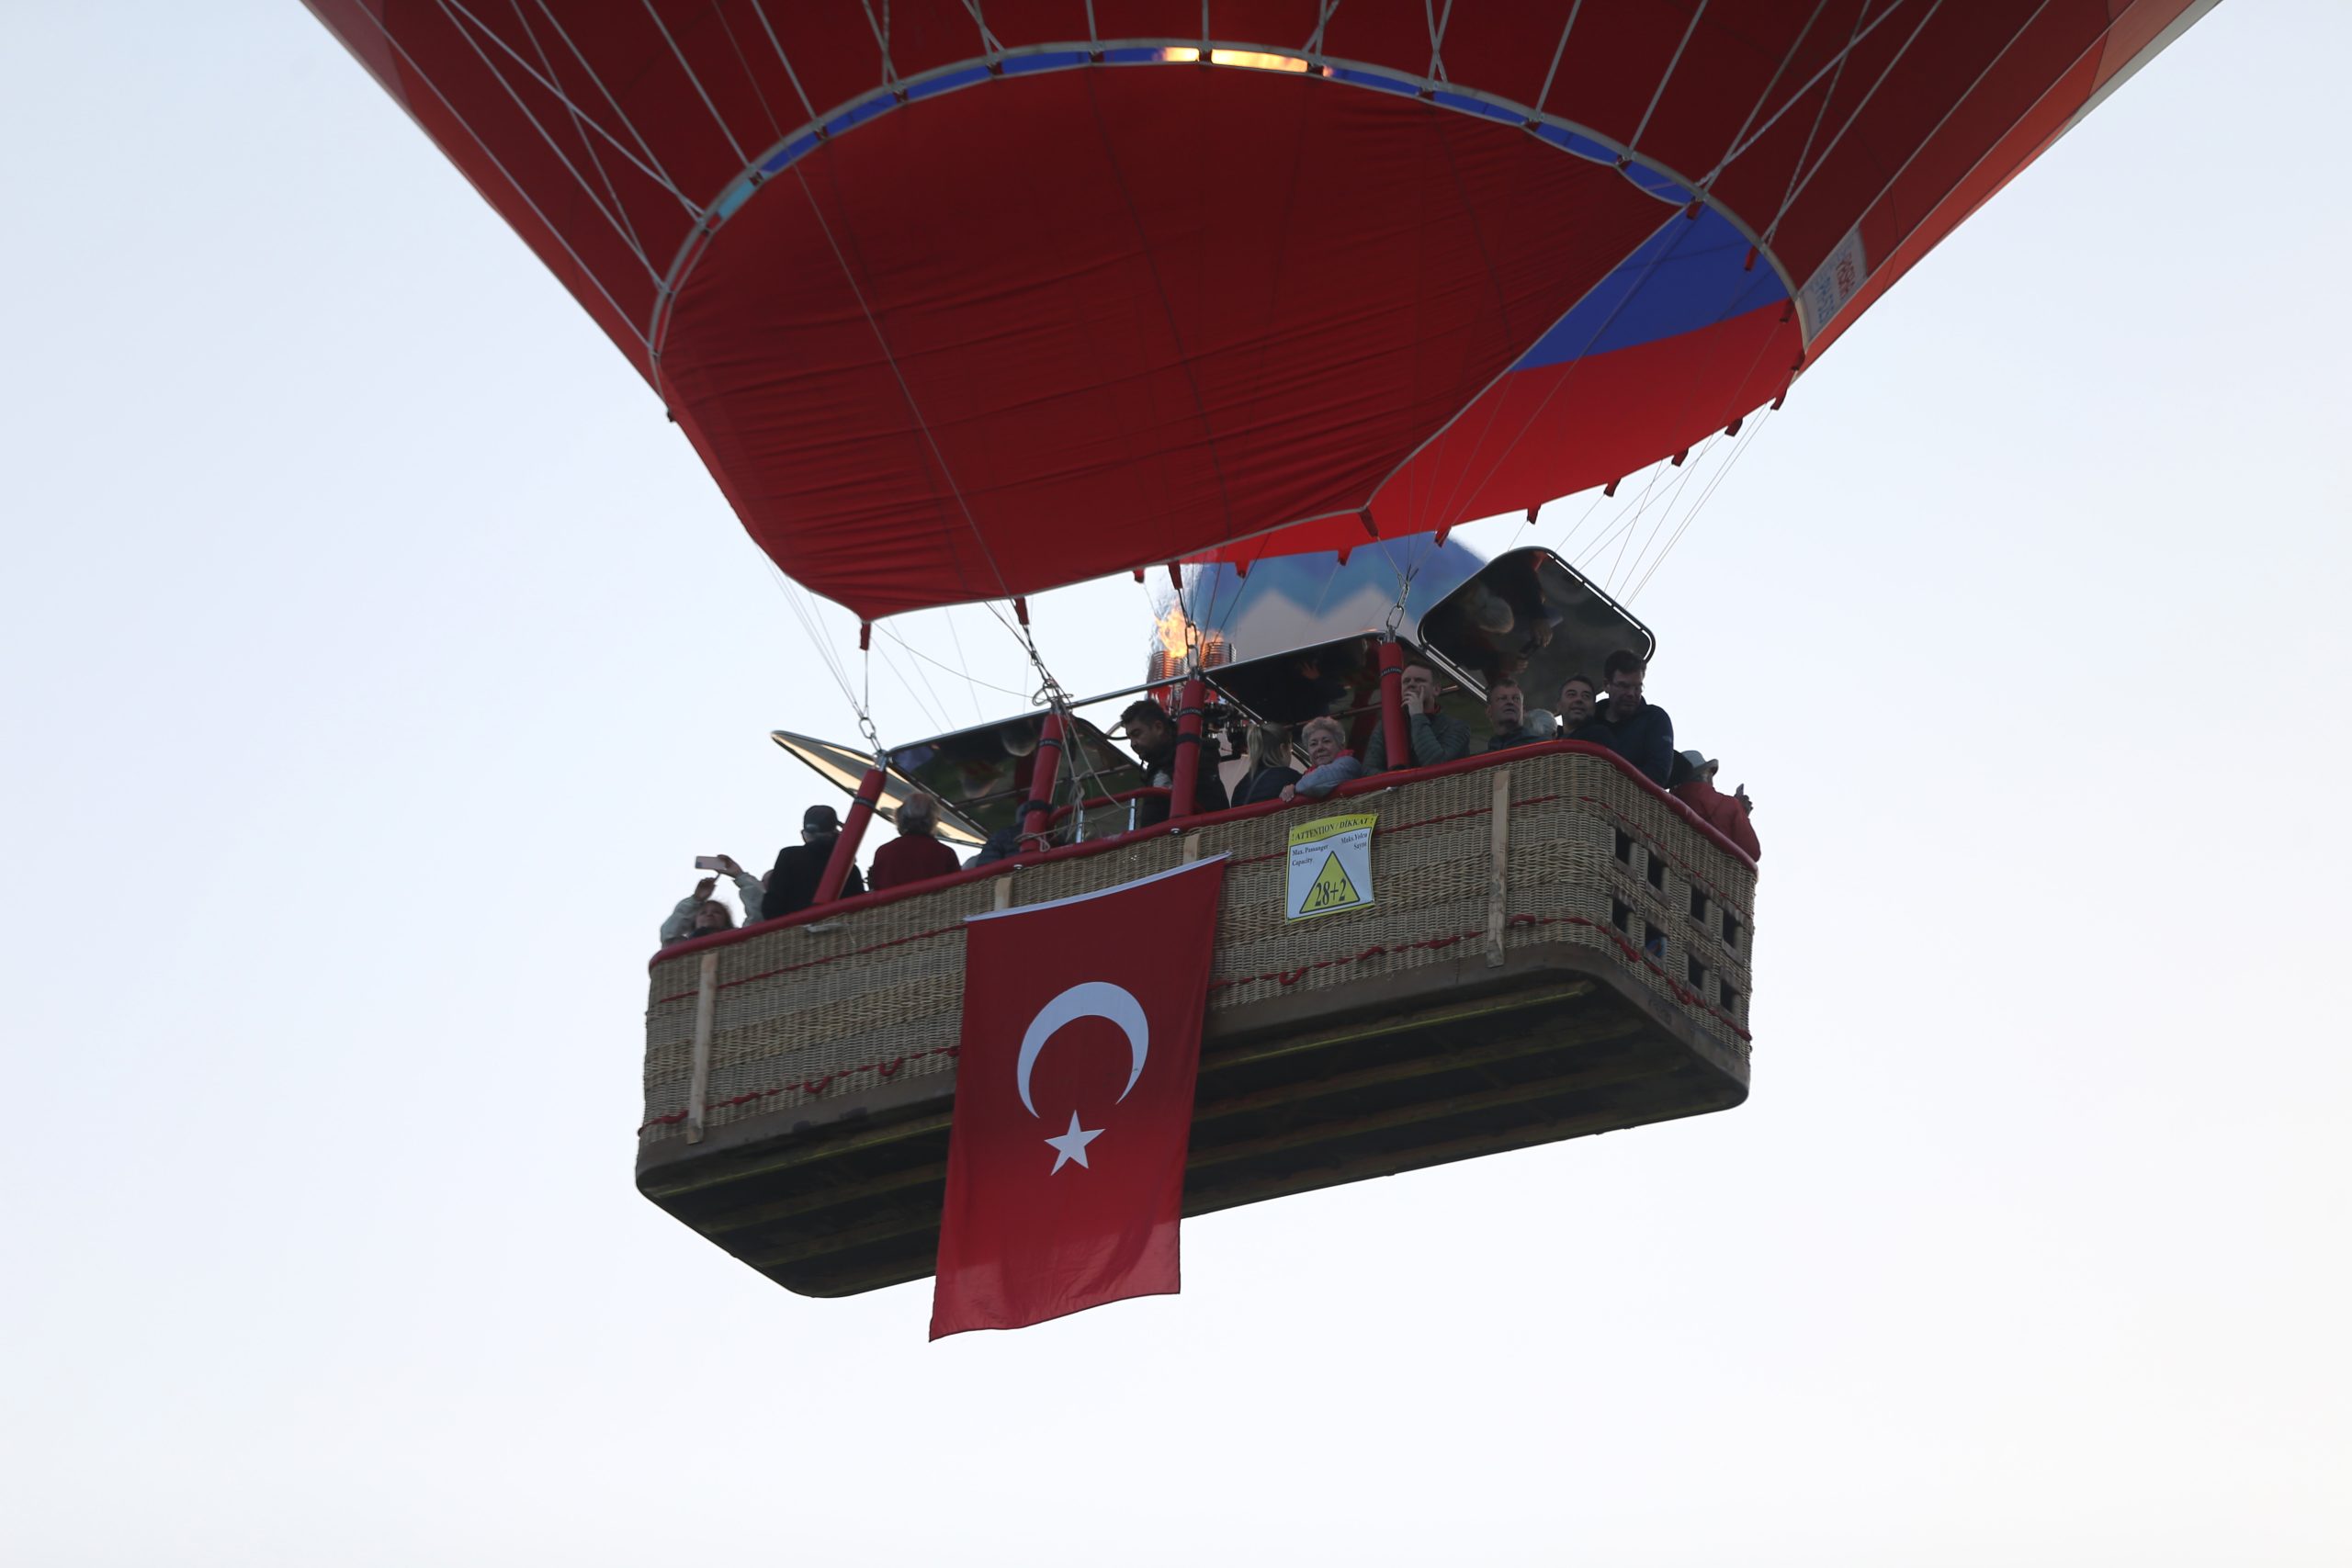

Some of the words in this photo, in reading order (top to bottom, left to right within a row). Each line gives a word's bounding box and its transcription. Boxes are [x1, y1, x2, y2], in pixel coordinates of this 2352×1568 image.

[1295, 823, 1334, 840] ATTENTION
[1292, 858, 1313, 867] Capacity
[1315, 877, 1347, 907] 28+2
